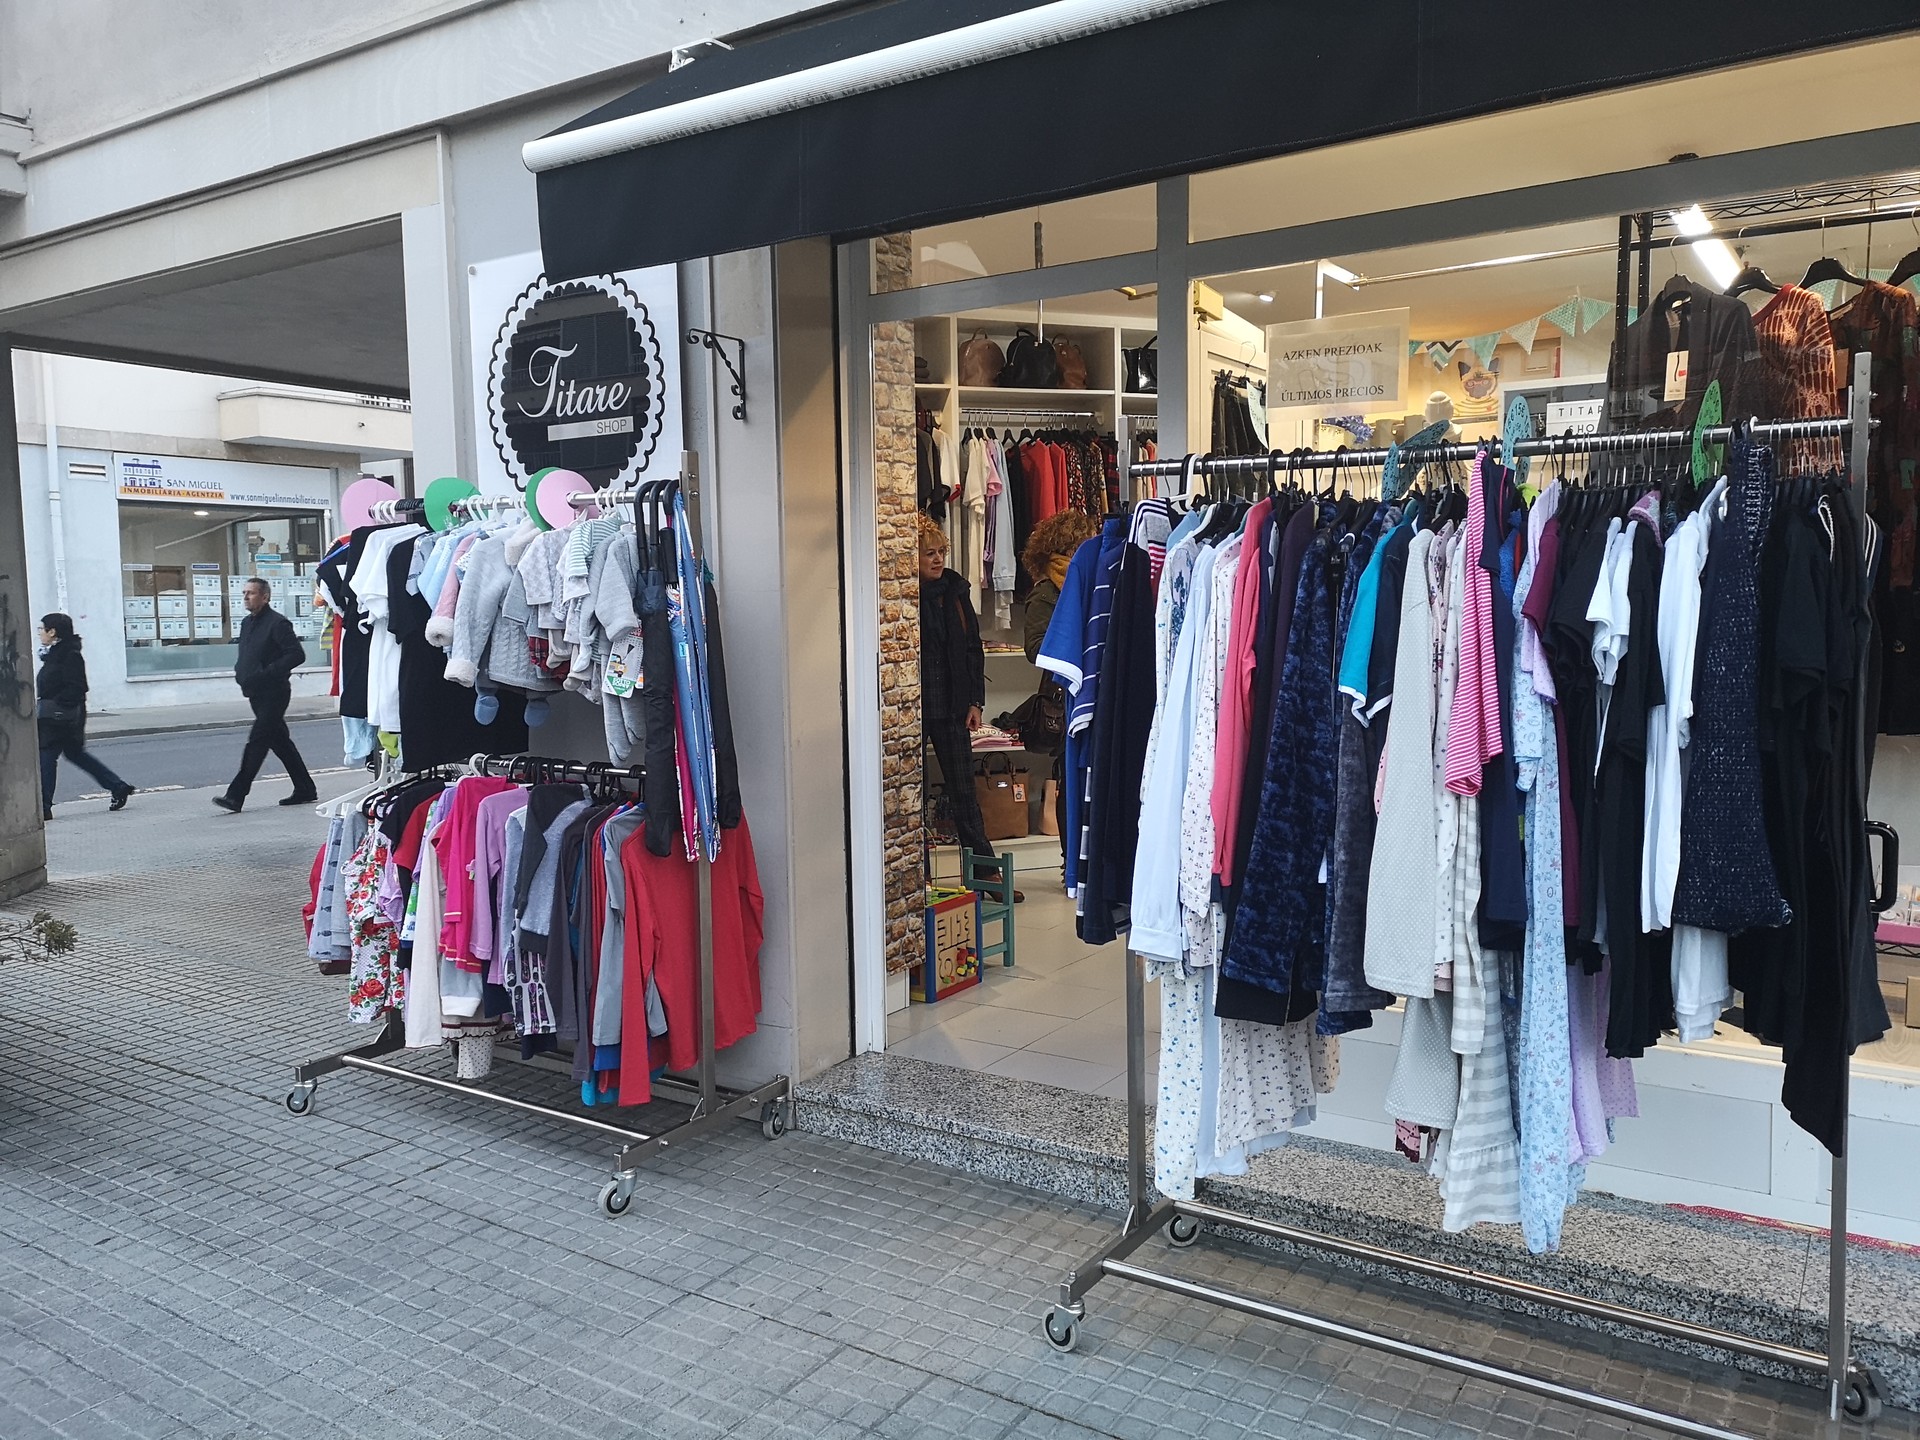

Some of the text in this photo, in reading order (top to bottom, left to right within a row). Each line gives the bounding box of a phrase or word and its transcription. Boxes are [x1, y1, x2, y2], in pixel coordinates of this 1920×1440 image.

[1283, 343, 1383, 361] AZKEN PREZIOAK
[517, 343, 632, 418] Titare
[1281, 385, 1384, 402] ÚLTIMOS PRECIOS
[596, 419, 627, 434] SHOP
[166, 479, 224, 490] SAN MIGUEL
